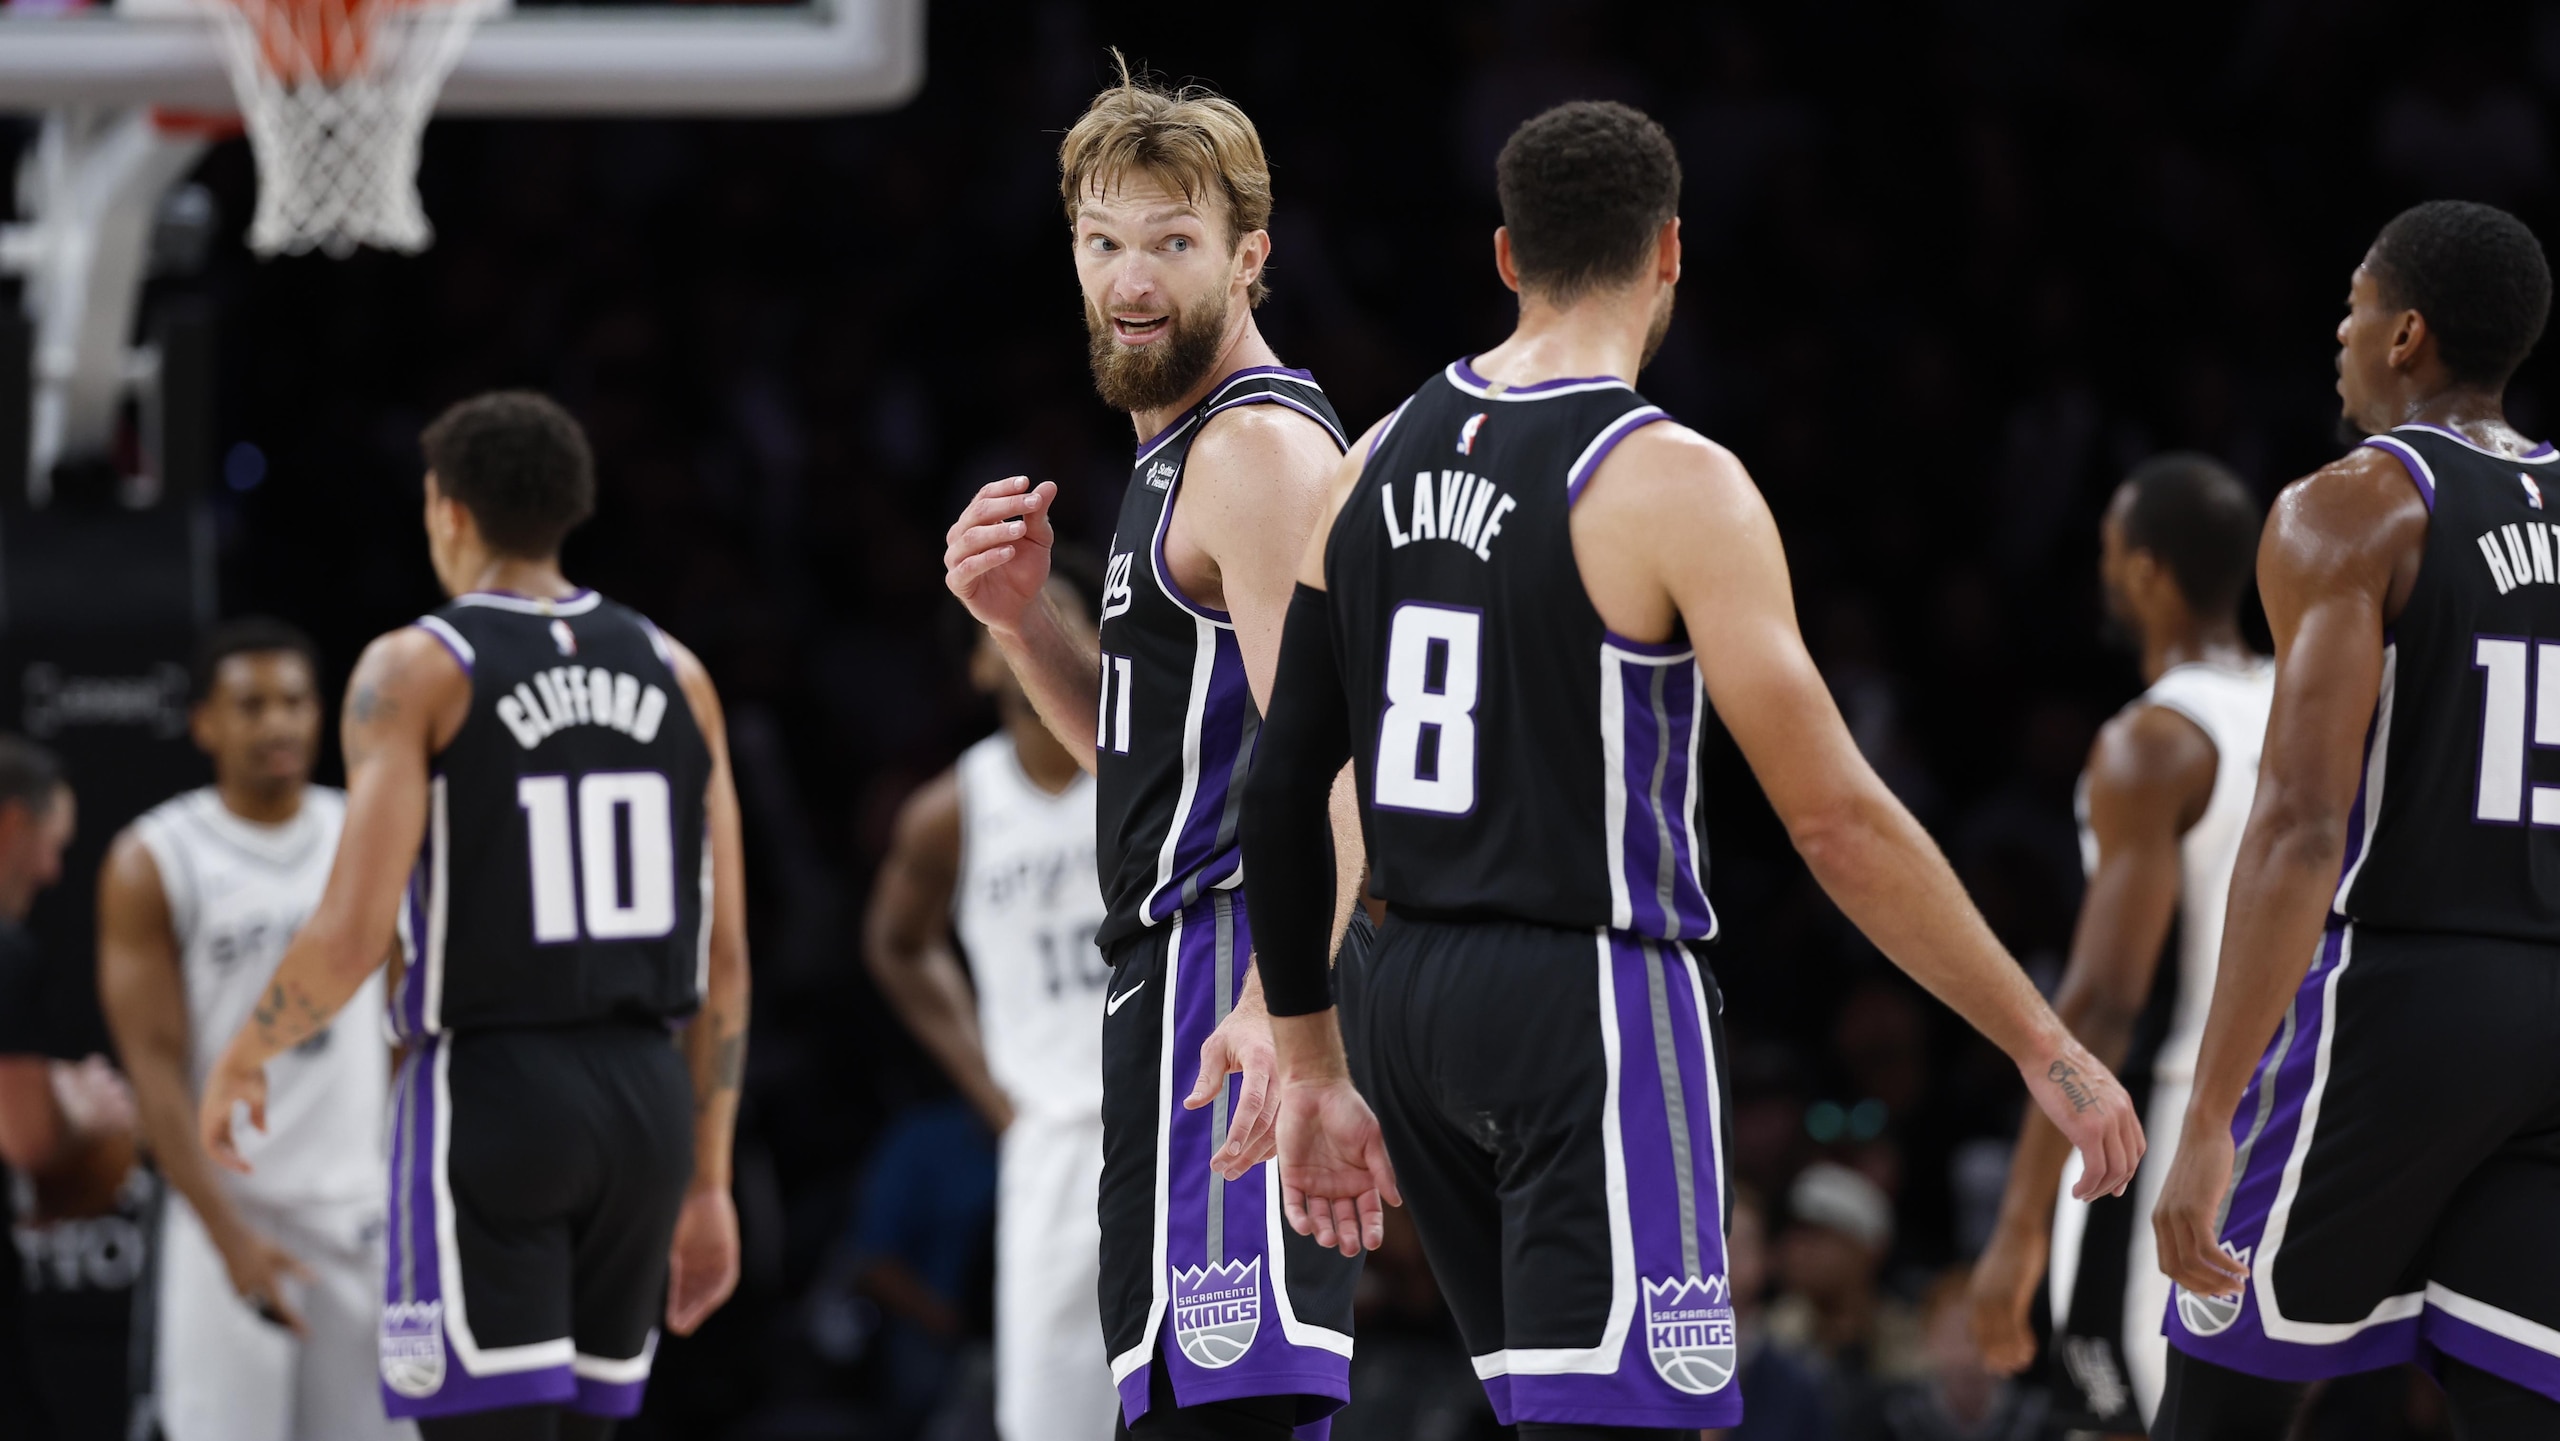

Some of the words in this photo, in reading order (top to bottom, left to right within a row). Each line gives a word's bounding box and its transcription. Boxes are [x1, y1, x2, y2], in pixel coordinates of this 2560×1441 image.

[1382, 469, 1517, 562] LAVINE
[497, 665, 668, 750] CLIFFORD
[1097, 652, 1132, 754] 11
[1373, 602, 1482, 816] 8
[517, 770, 677, 944] 10
[2048, 1060, 2104, 1114] Saint
[1177, 1300, 1257, 1332] KINGS
[1179, 1286, 1254, 1306] SACRAMENTO
[1651, 1324, 1734, 1349] KINGS
